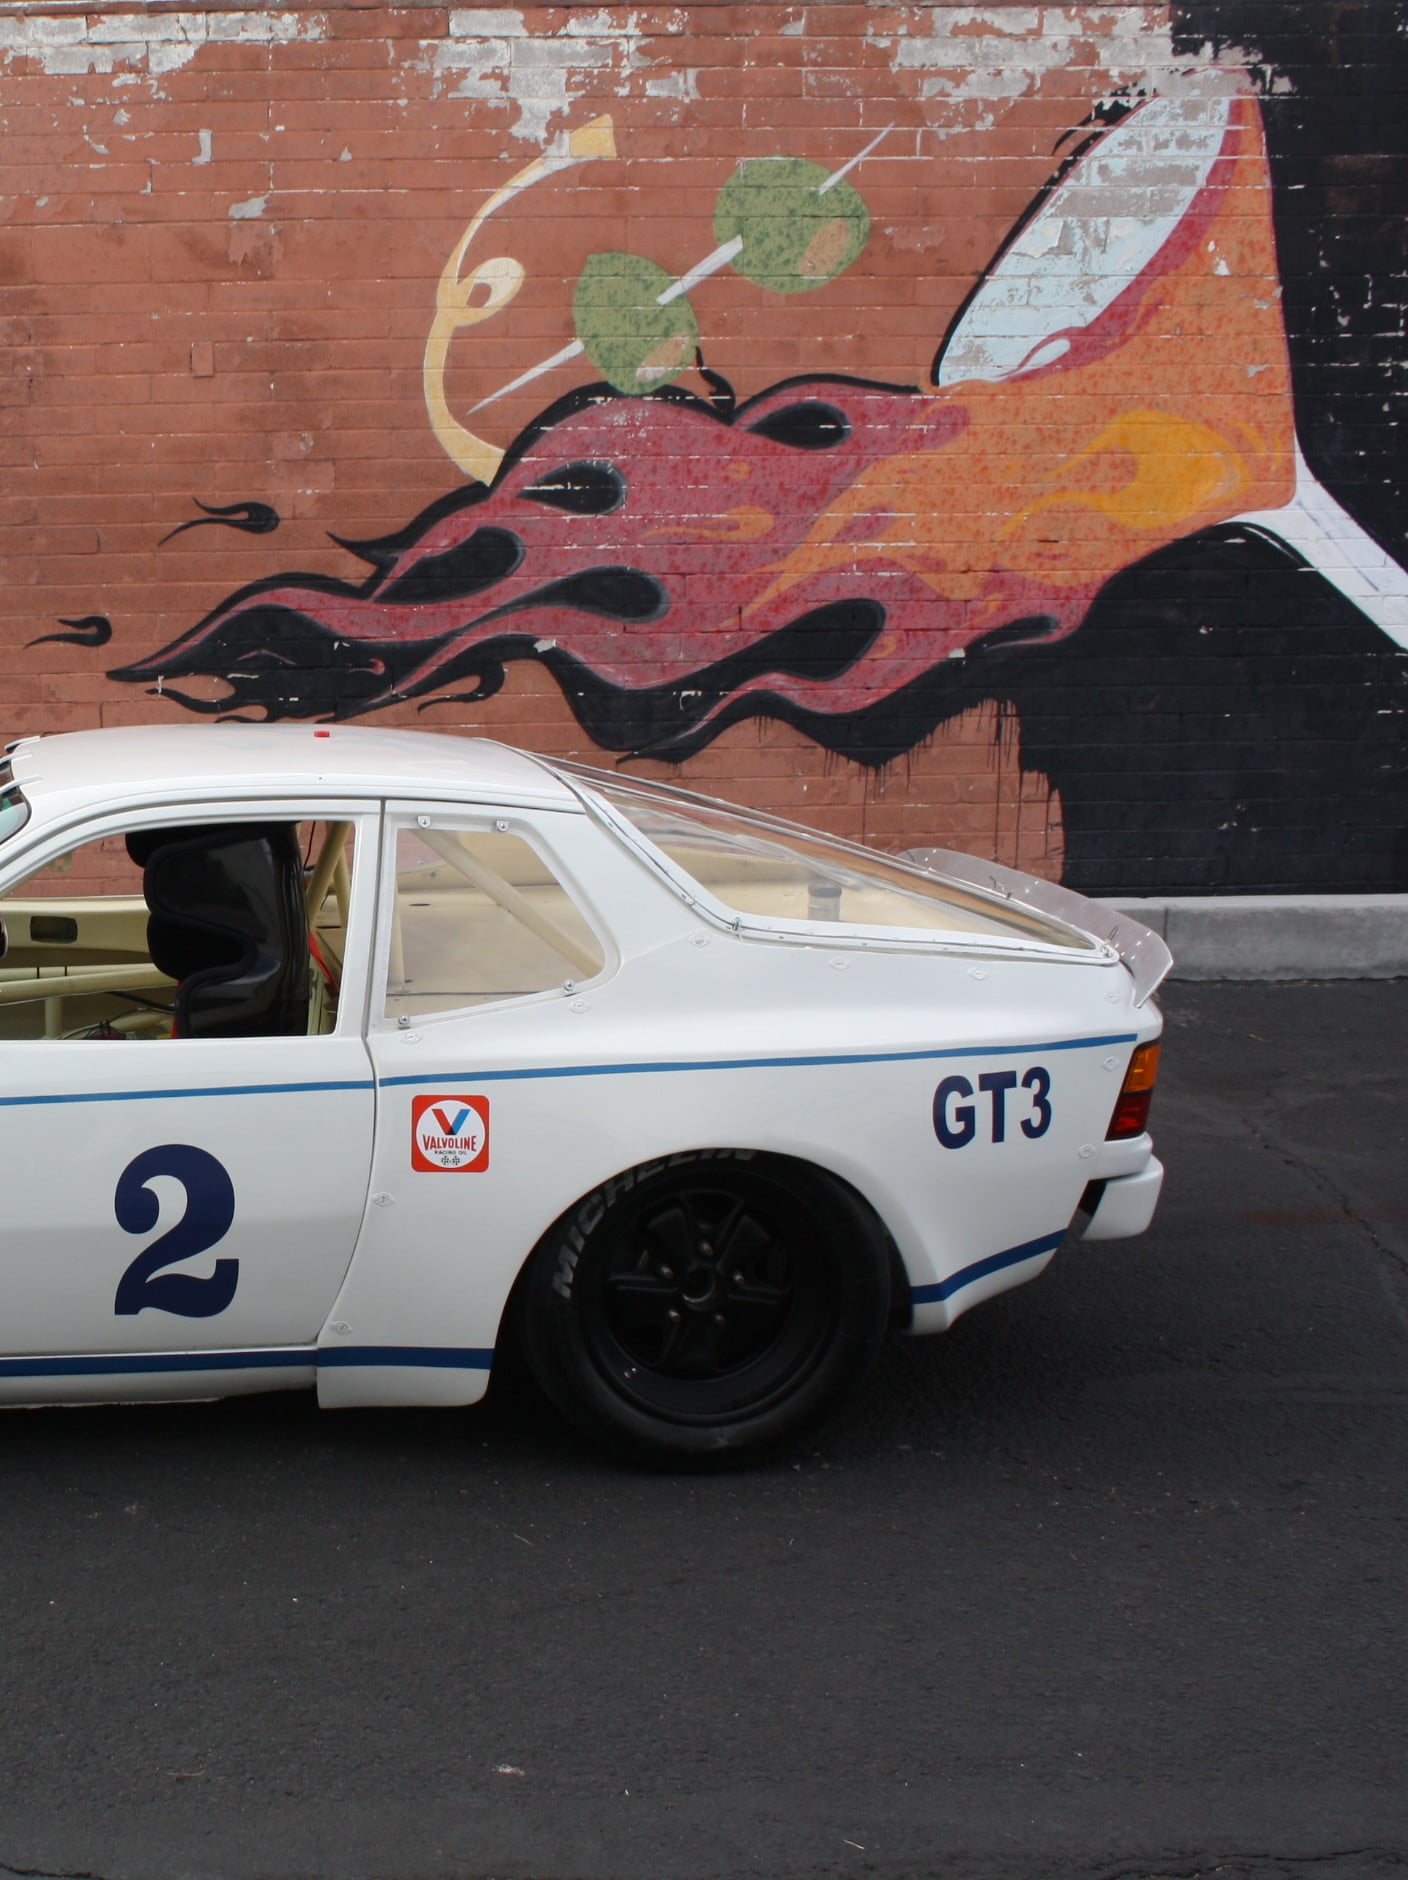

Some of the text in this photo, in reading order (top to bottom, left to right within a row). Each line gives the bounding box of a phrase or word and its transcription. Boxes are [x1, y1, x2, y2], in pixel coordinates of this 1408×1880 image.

[422, 1134, 477, 1152] VALVOLINE
[932, 1066, 1052, 1150] GT3
[114, 1143, 240, 1318] 2
